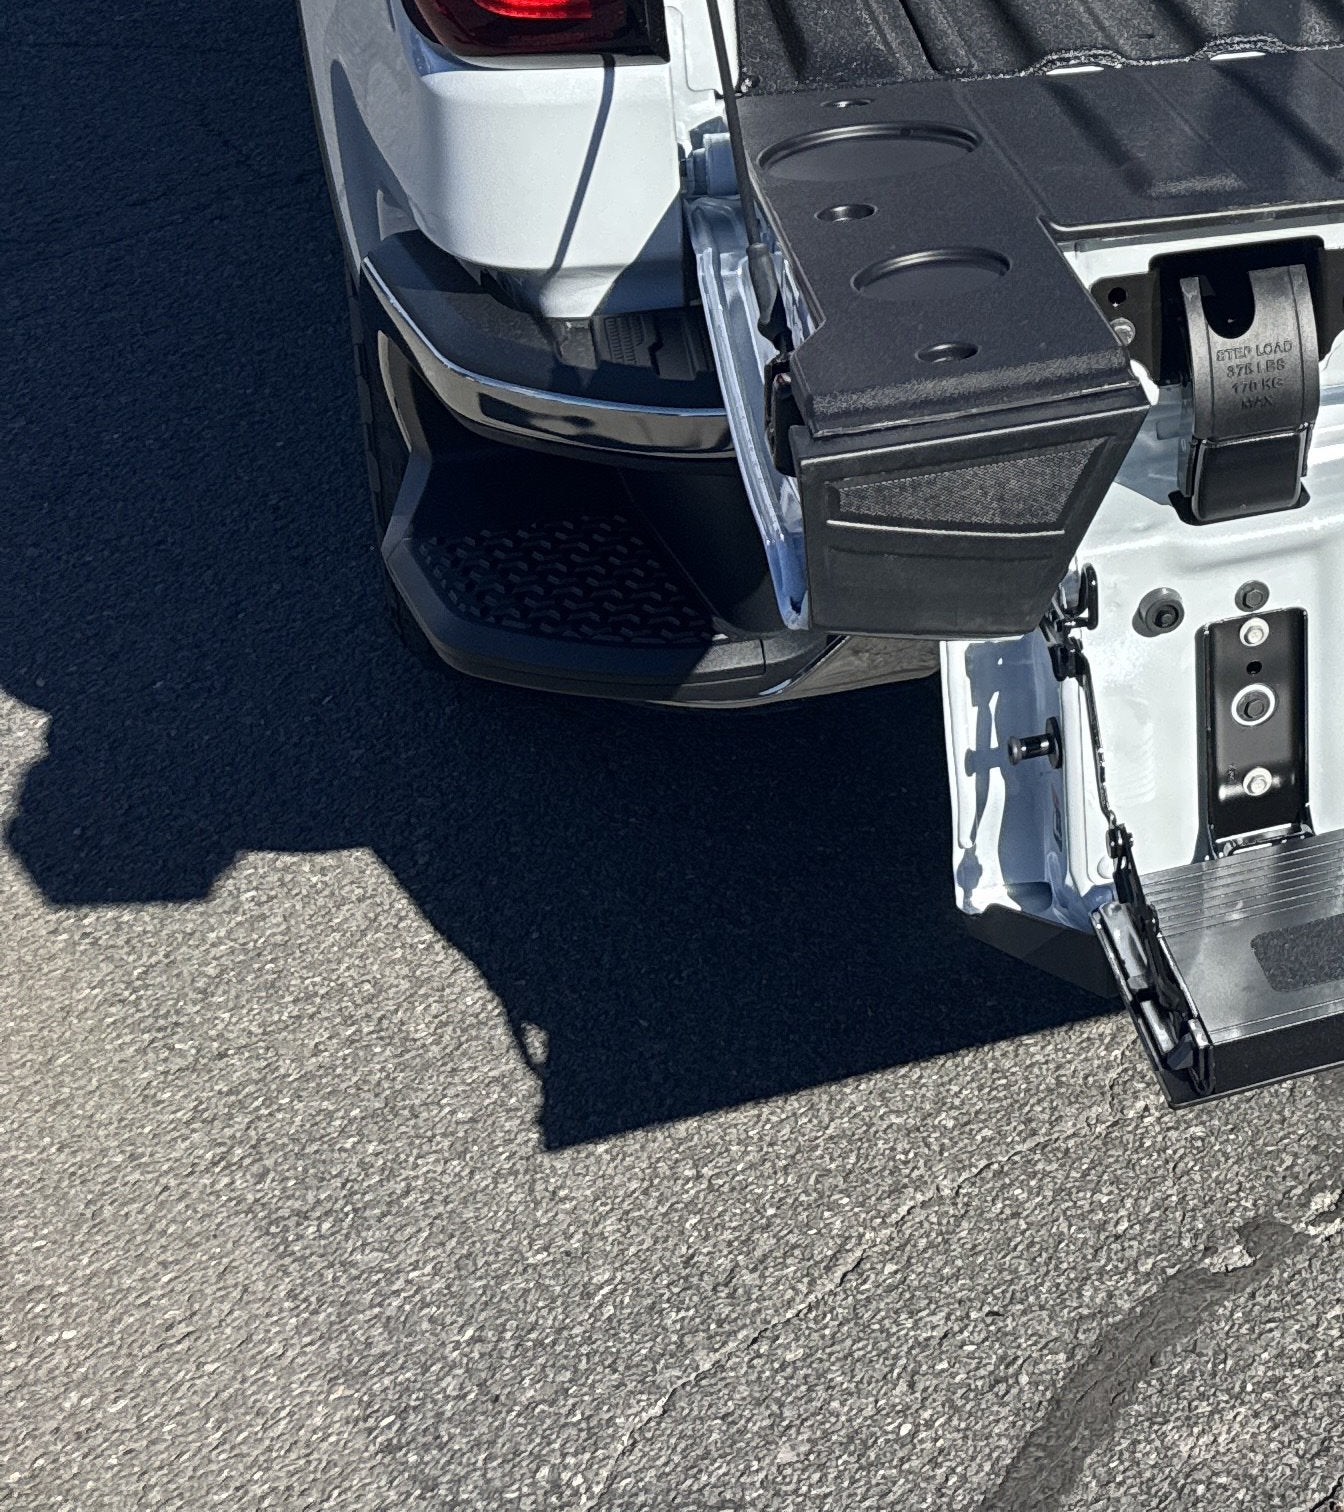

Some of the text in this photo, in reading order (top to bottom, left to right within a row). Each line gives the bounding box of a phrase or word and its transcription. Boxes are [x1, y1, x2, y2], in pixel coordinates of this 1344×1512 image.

[1216, 340, 1293, 361] STEP LOAD
[1261, 376, 1284, 390] KG
